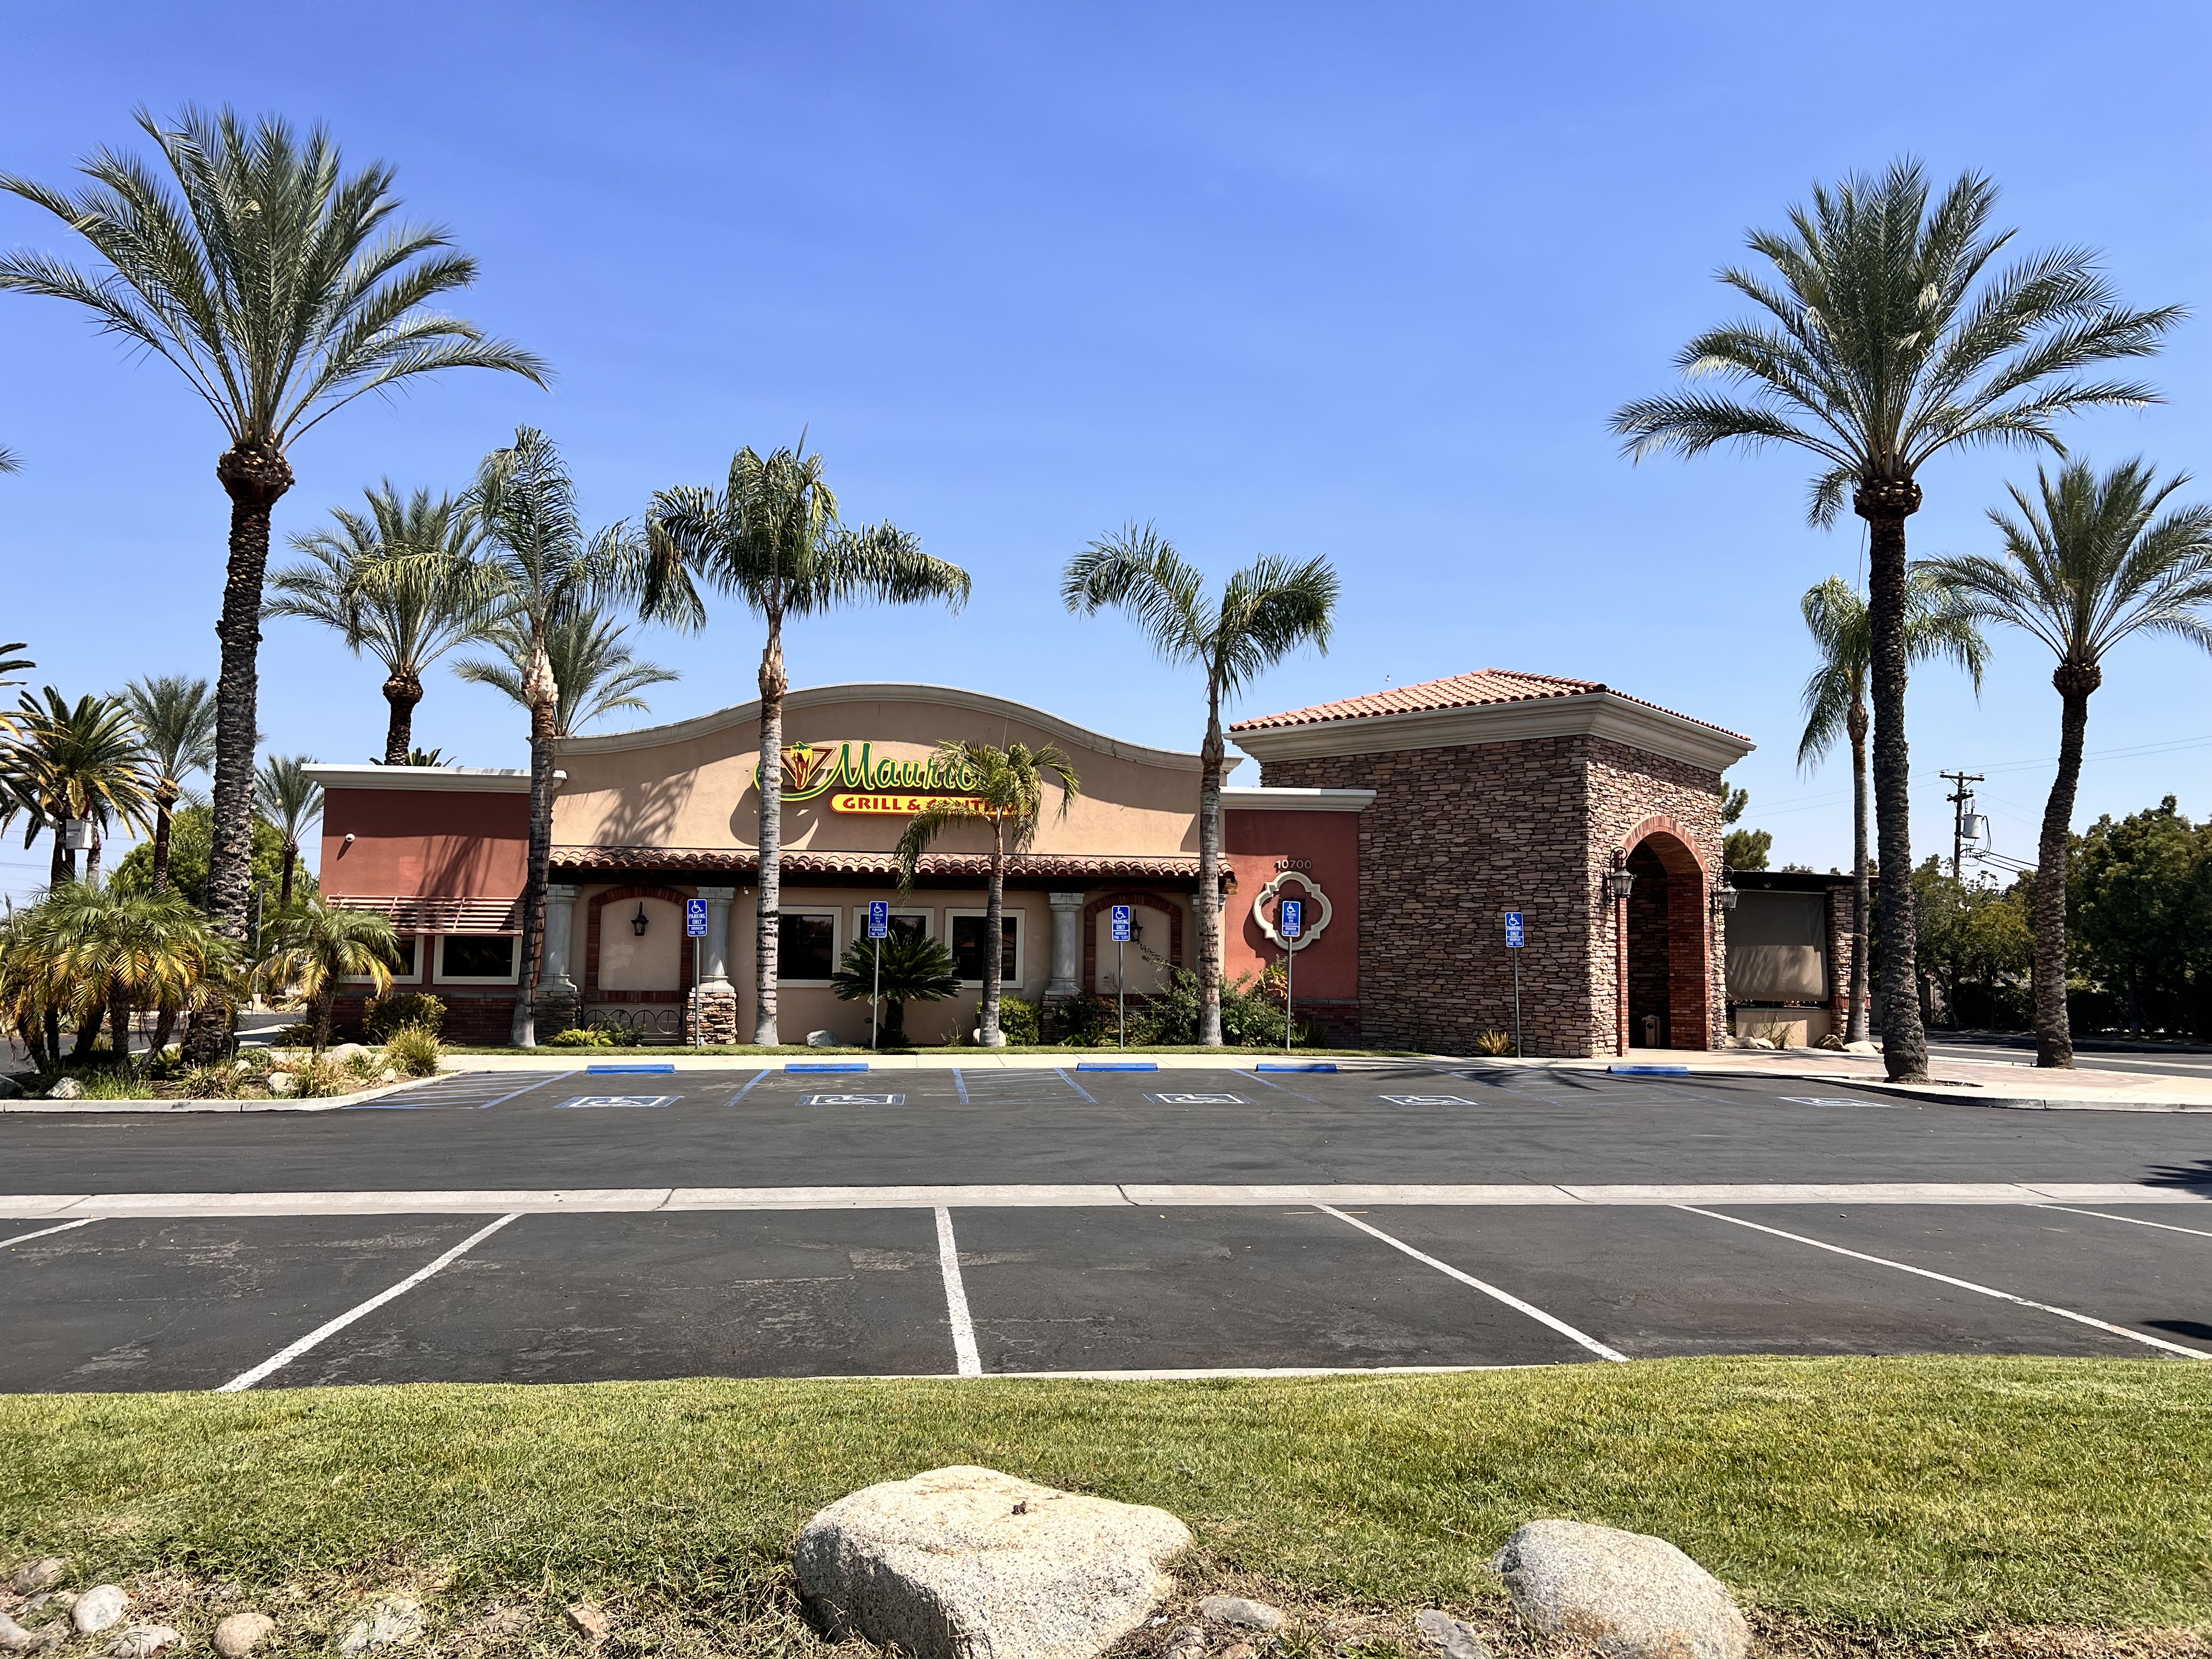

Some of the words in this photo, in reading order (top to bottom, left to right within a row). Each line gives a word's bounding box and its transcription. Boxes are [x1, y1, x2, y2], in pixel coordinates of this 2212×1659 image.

[842, 797, 902, 811] GRILL
[907, 797, 921, 811] &
[1276, 860, 1312, 869] 10700
